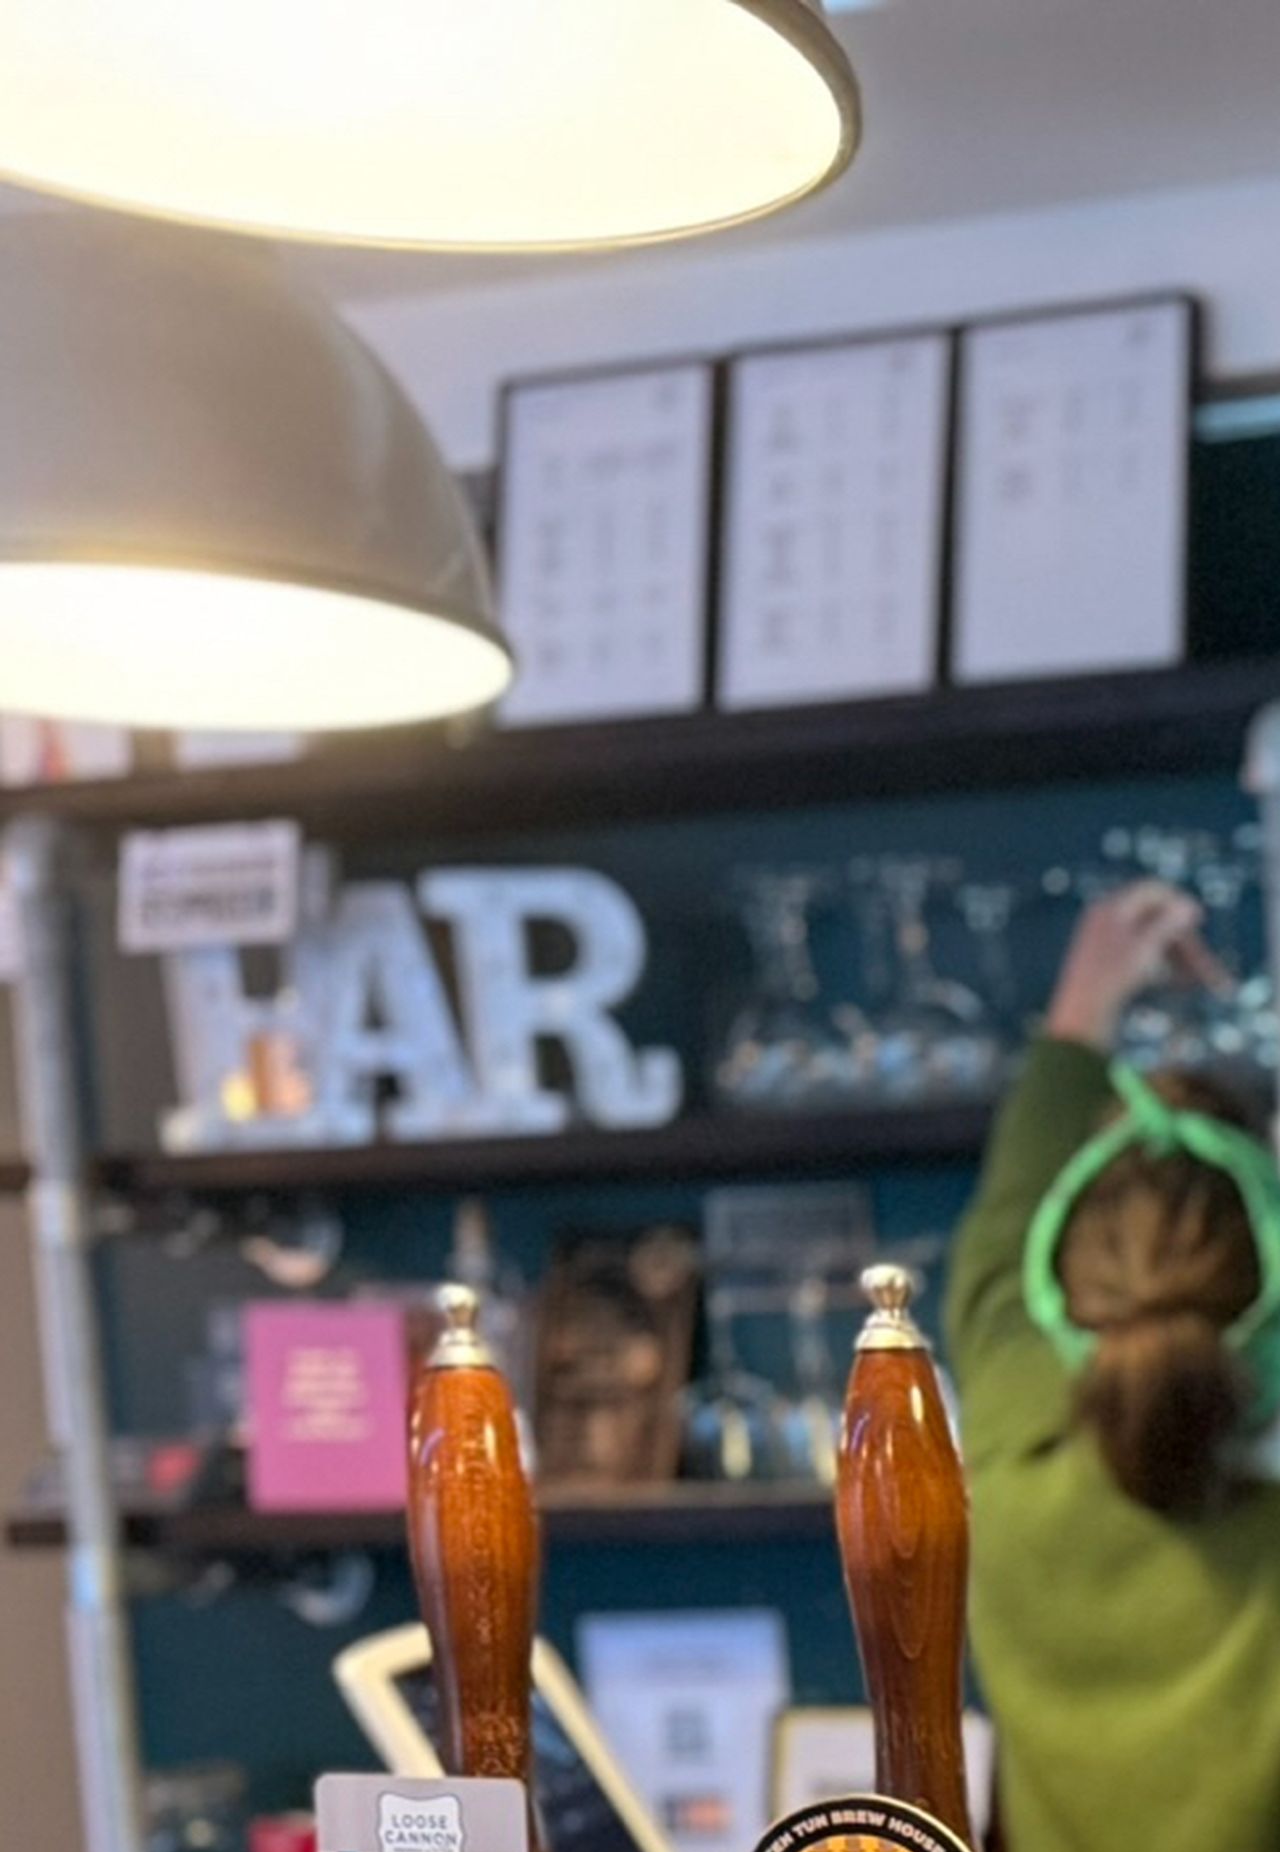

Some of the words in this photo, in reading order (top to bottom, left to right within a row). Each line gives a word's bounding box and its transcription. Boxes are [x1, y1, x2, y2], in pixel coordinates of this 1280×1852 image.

[391, 1813, 448, 1829] LOOSE
[793, 1810, 829, 1832] TUN
[830, 1808, 887, 1826] BREW
[384, 1830, 458, 1846] CANNON
